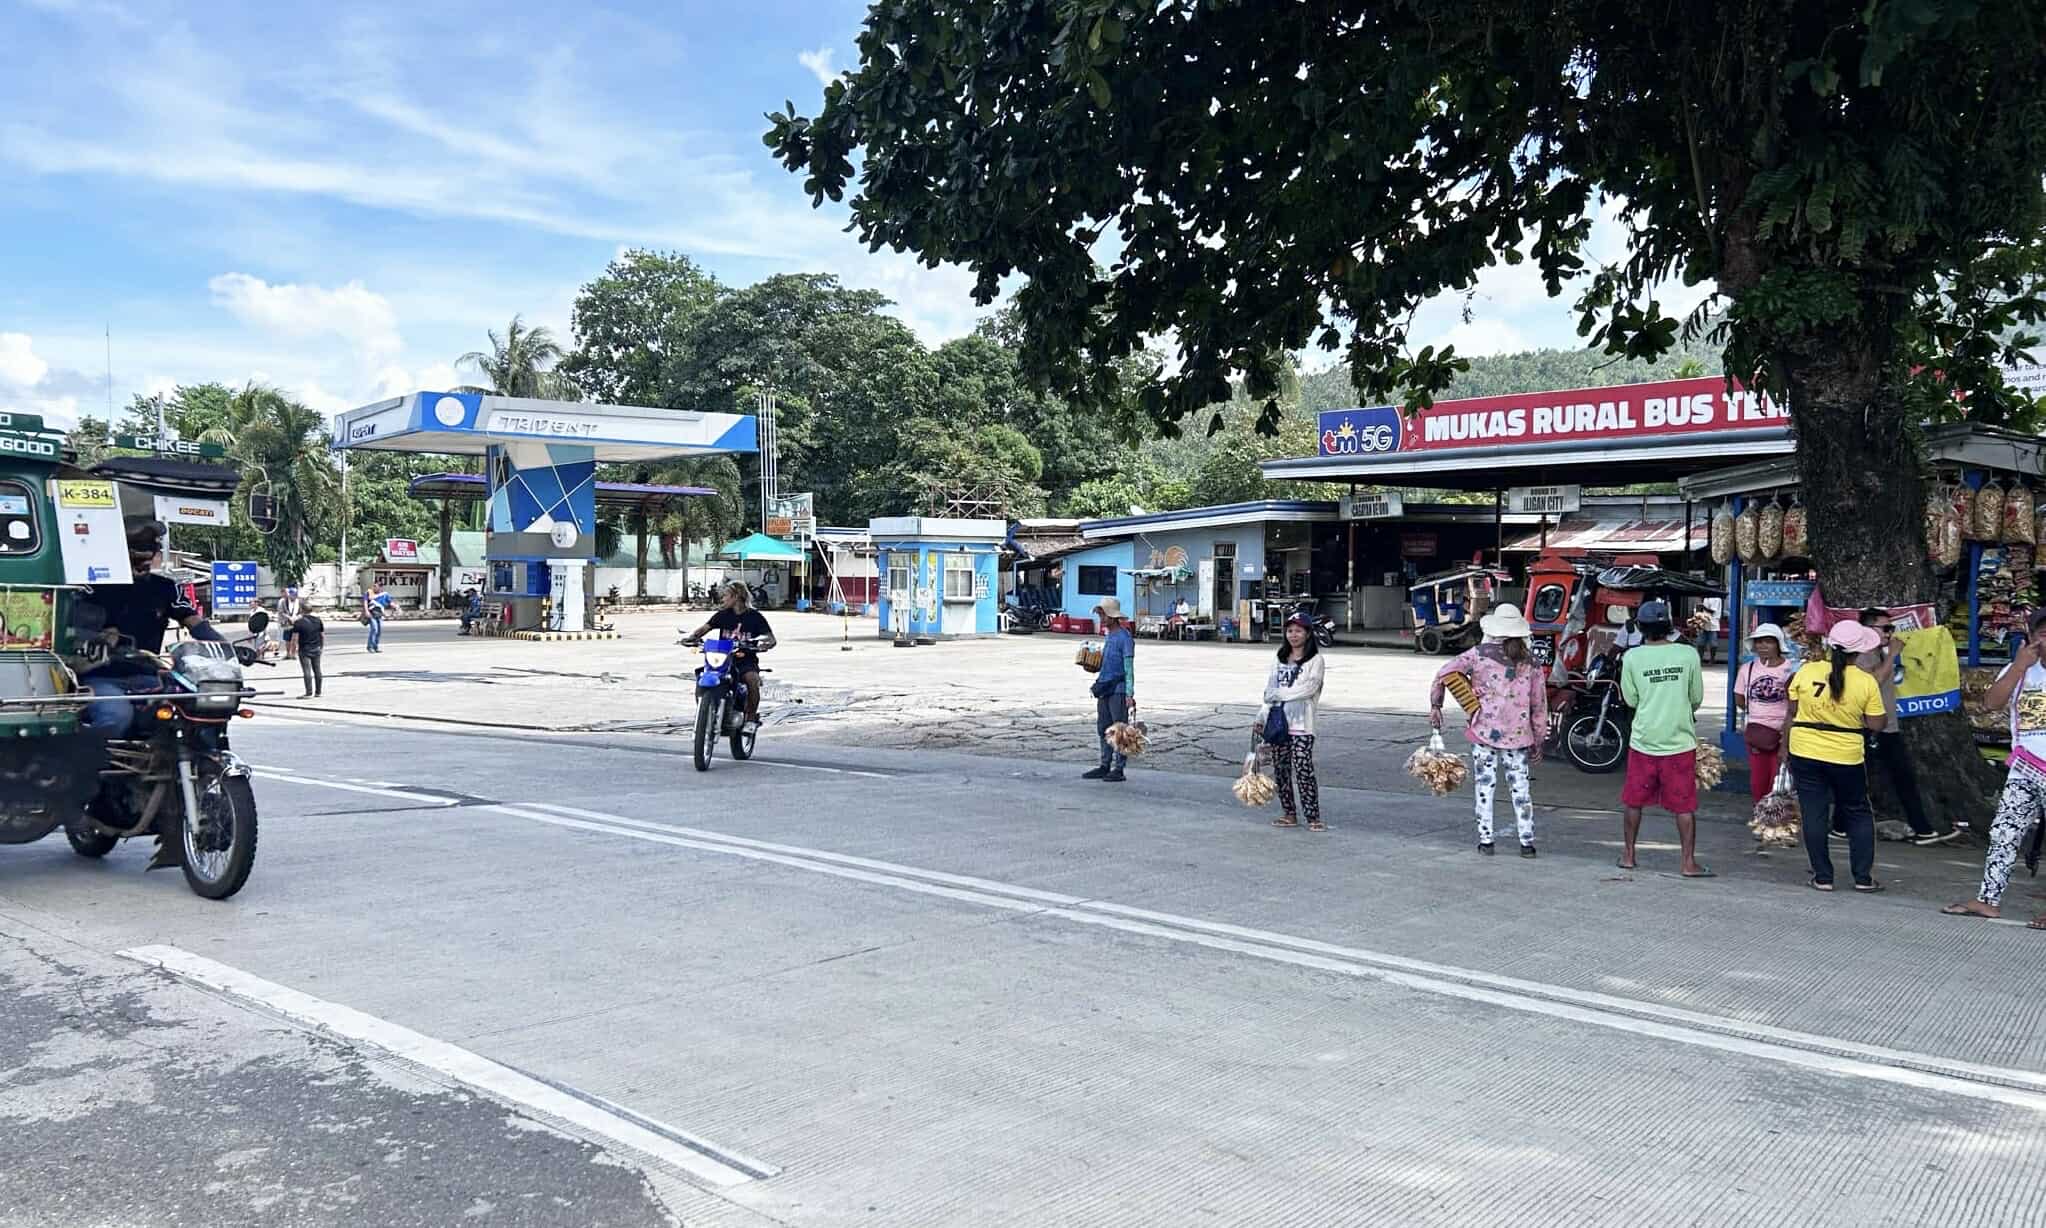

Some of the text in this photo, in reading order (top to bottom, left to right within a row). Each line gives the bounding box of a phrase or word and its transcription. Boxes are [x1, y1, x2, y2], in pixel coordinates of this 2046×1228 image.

[1424, 408, 1526, 442] MUKAS
[1533, 401, 1636, 434] RURAL
[1644, 394, 1714, 428] BUS
[499, 416, 599, 438] TRIDENT
[135, 437, 201, 454] CHIKEE
[1361, 424, 1393, 452] 5G
[1547, 496, 1564, 511] CITY
[1812, 681, 1826, 698] 7
[1908, 697, 1949, 713] DITO!
